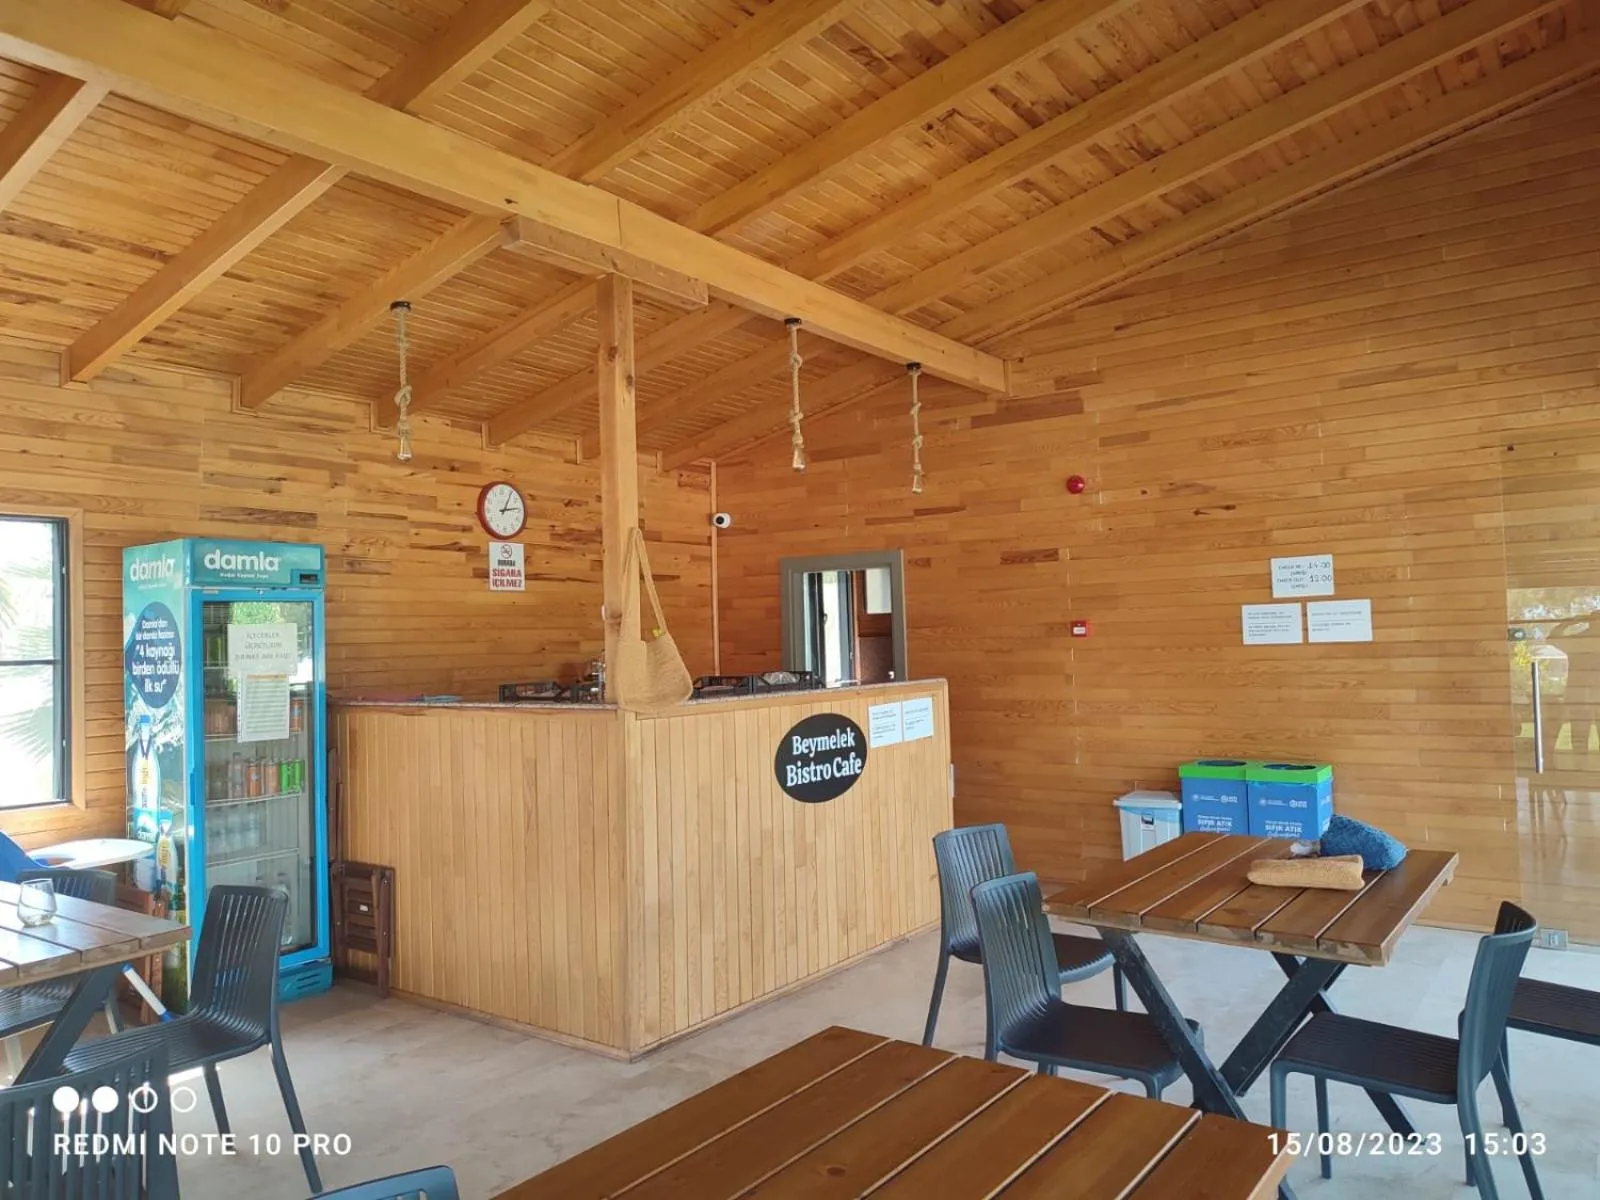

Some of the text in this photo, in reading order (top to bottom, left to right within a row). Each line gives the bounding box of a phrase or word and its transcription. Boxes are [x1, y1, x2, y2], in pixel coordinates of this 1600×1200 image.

[130, 554, 175, 582] damla
[204, 549, 280, 571] damla
[132, 661, 155, 675] birden
[792, 727, 856, 758] Beymelek
[786, 752, 863, 787] Bistro Cafe
